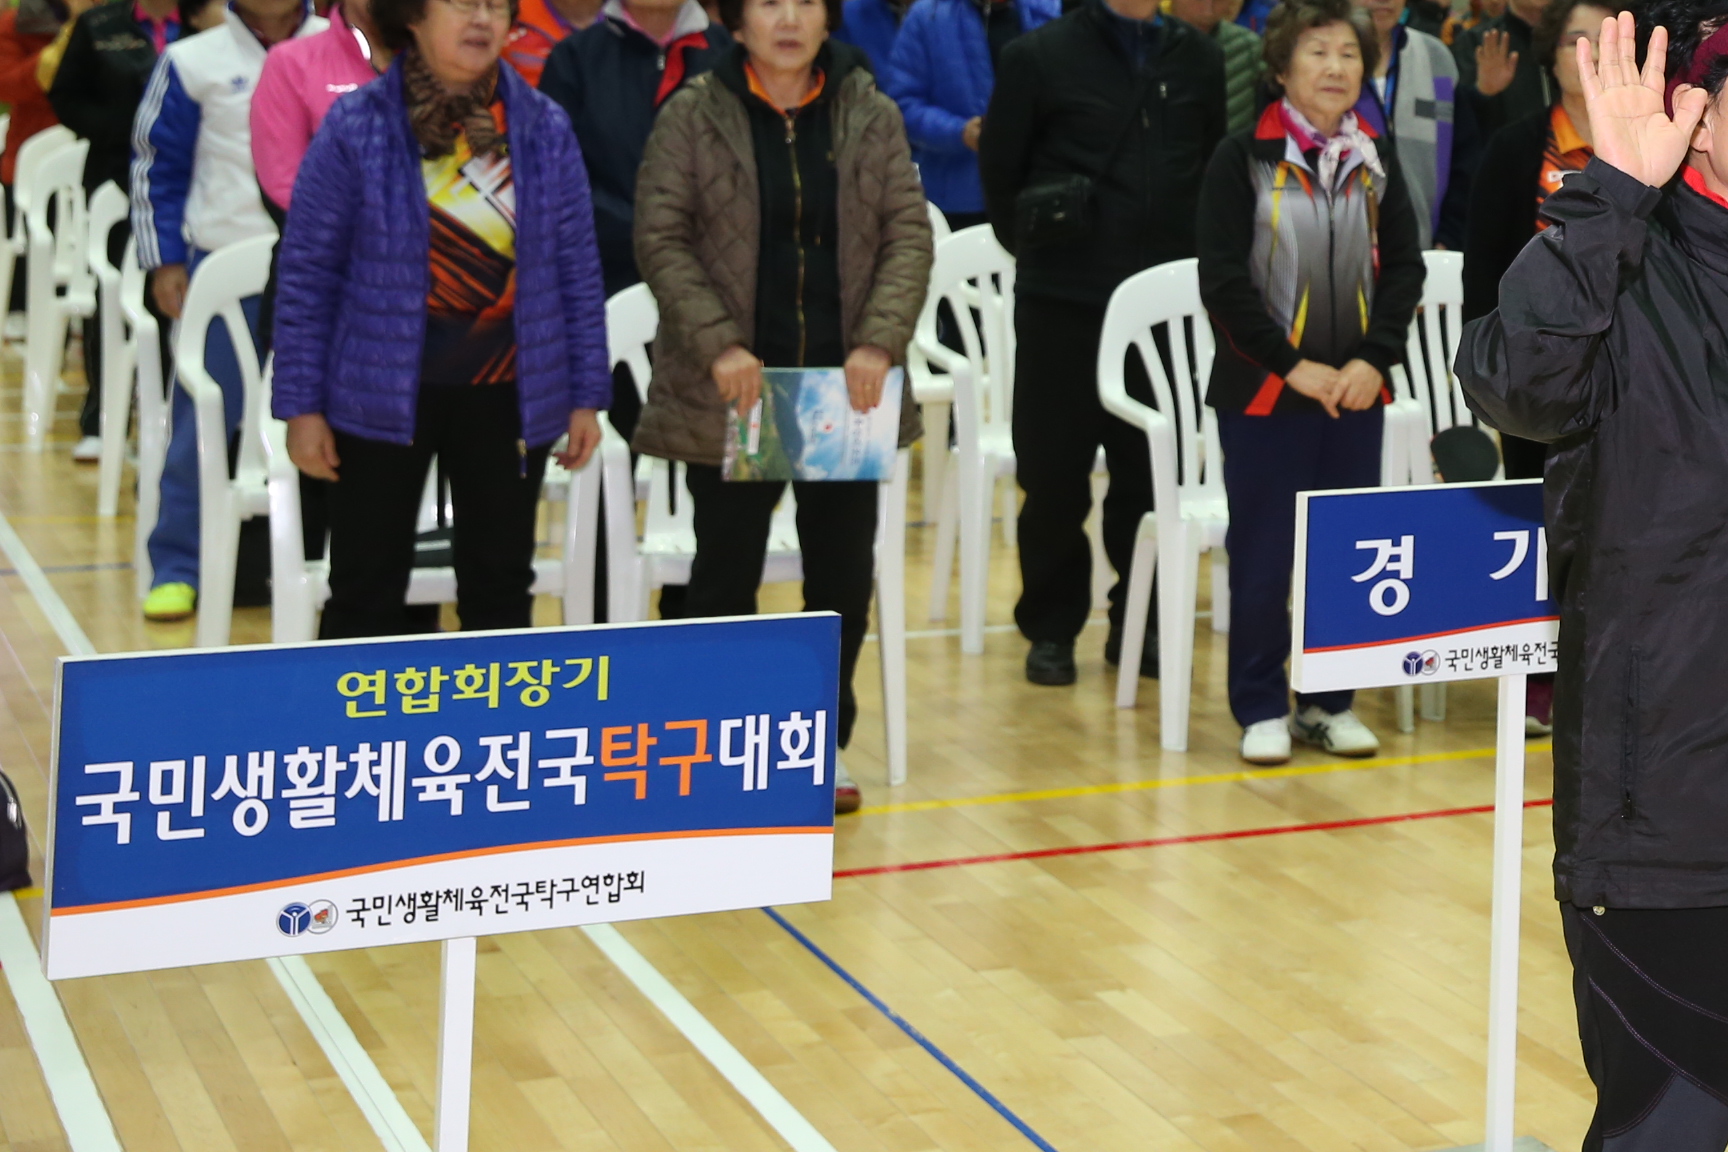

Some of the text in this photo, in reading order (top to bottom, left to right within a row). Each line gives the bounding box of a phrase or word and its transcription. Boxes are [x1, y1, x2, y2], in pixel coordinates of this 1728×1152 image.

[336, 655, 609, 718] 연합회장기
[75, 710, 826, 844] 국민생활체육전국탁구대회
[346, 869, 645, 929] 국민생활체육전국탁구연합회
